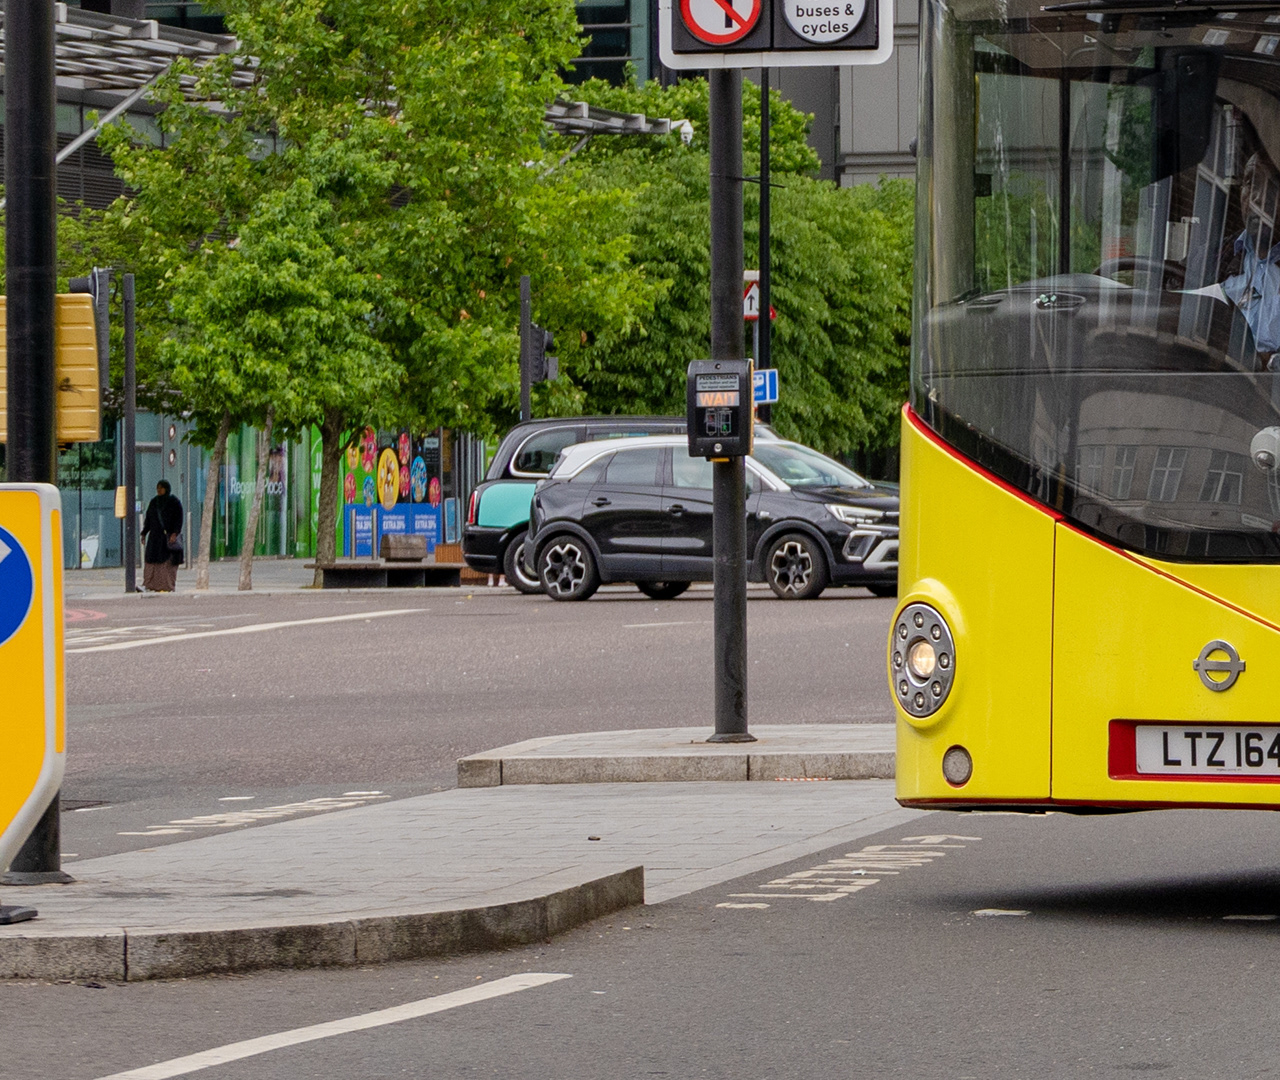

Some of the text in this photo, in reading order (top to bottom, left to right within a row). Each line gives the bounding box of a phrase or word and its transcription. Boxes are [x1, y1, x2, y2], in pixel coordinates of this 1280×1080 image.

[796, 3, 855, 17] buses &
[802, 20, 849, 36] cycles
[699, 392, 736, 407] WAIT
[1163, 731, 1225, 767] LTZ
[727, 845, 966, 901] LOOK LEFT
